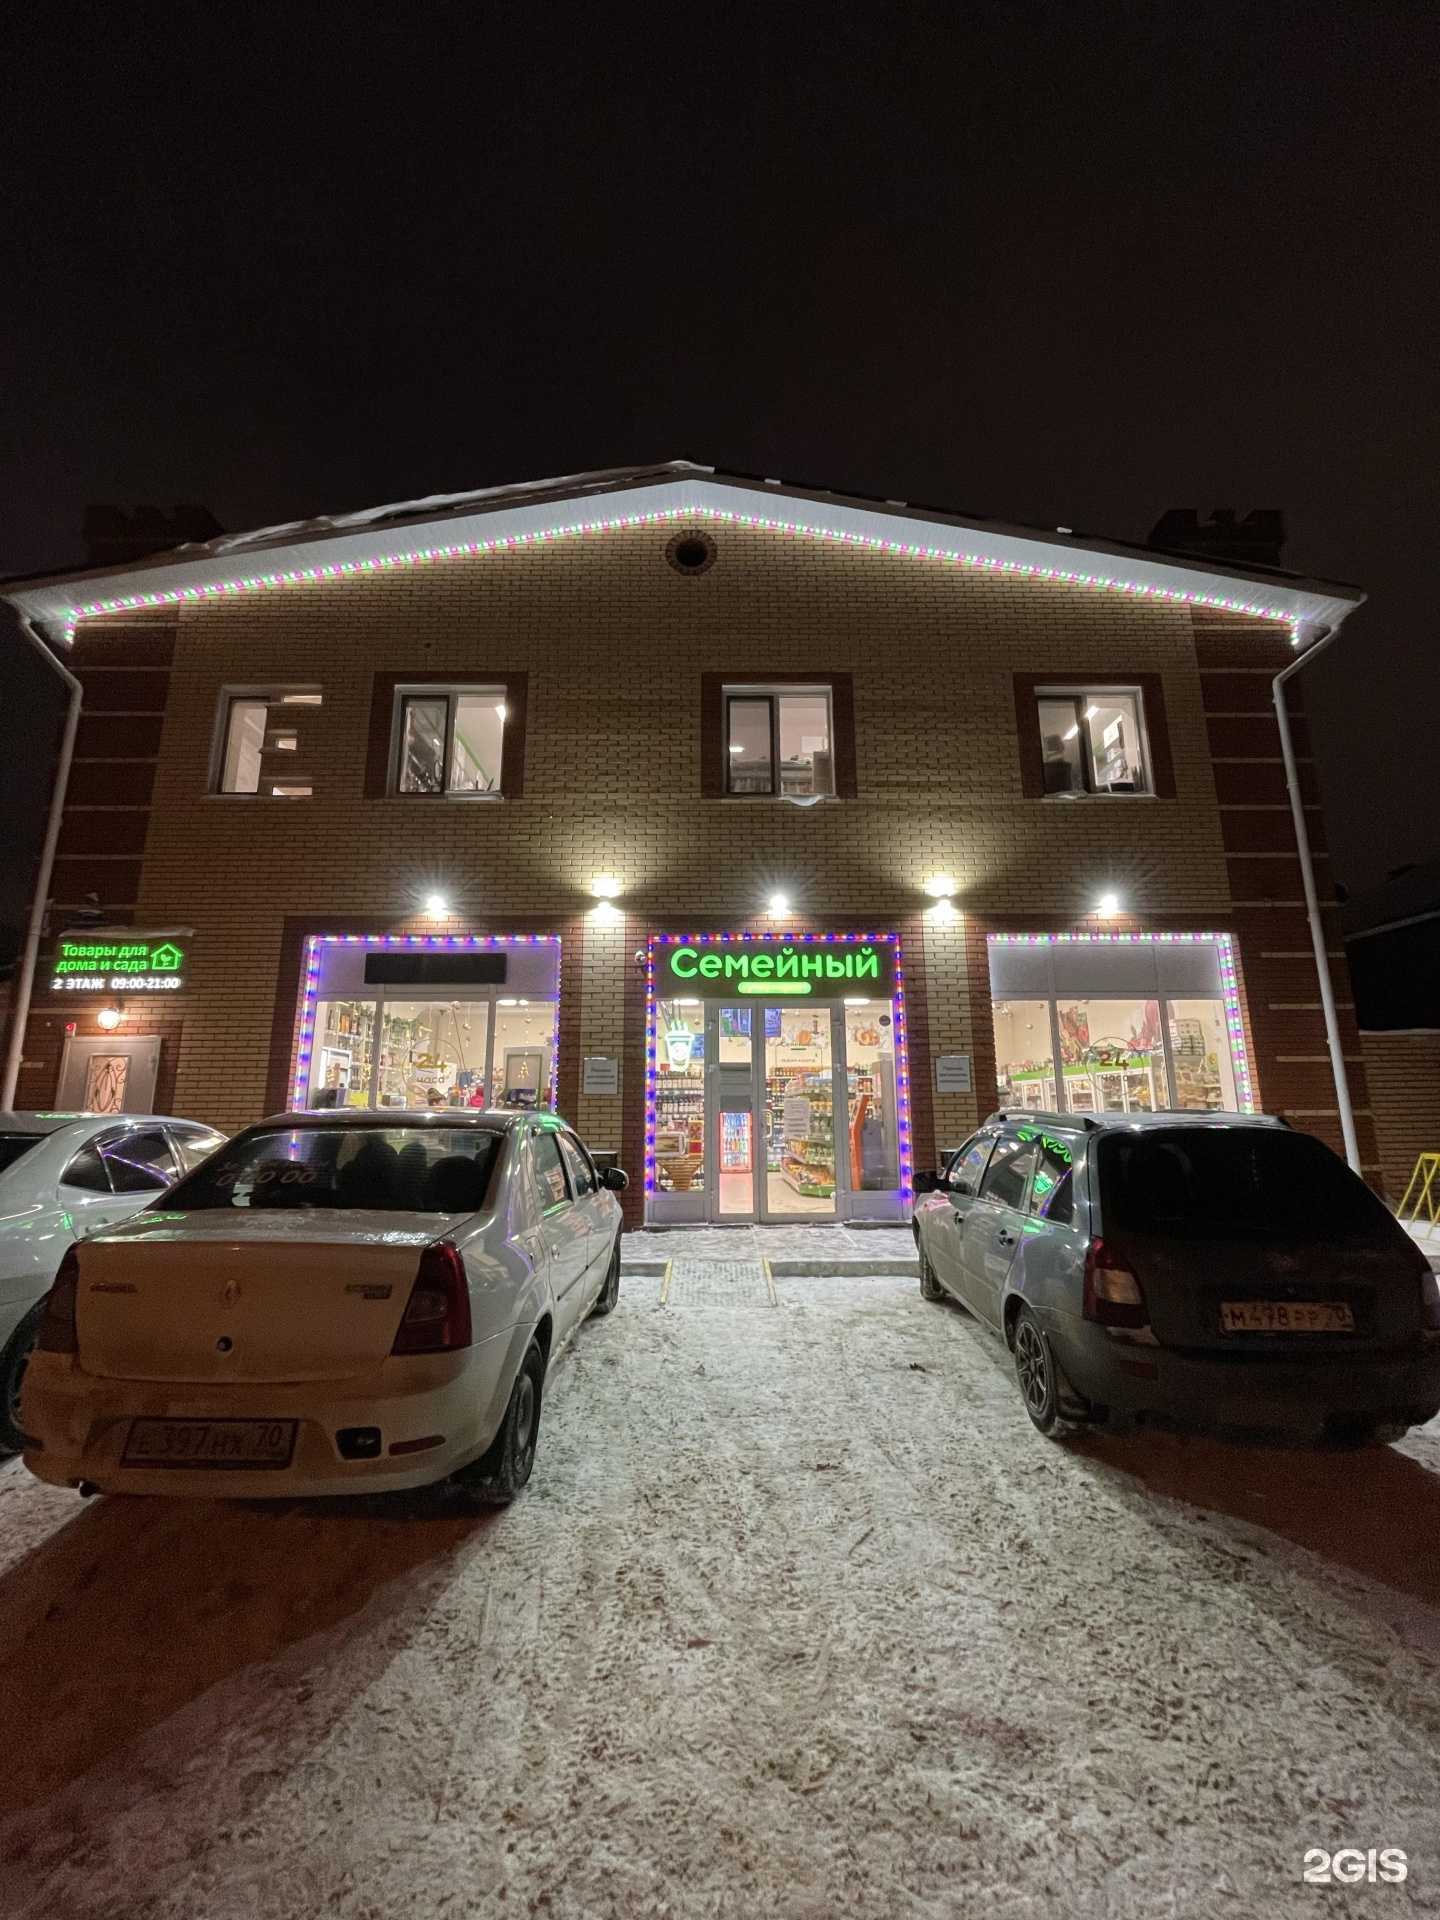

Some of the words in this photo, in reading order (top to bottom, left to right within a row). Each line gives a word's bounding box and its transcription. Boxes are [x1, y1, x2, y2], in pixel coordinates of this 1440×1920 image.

[62, 944, 116, 958] Товары
[118, 945, 148, 958] для
[56, 960, 97, 973] дома
[100, 960, 111, 971] и
[113, 960, 148, 973] сада
[670, 947, 879, 978] Семейный
[52, 979, 63, 989] 2
[65, 978, 105, 989] ЭТАЖ
[110, 977, 181, 989] 09:00-21:00
[415, 1052, 448, 1073] 24
[1099, 1051, 1130, 1070] 24
